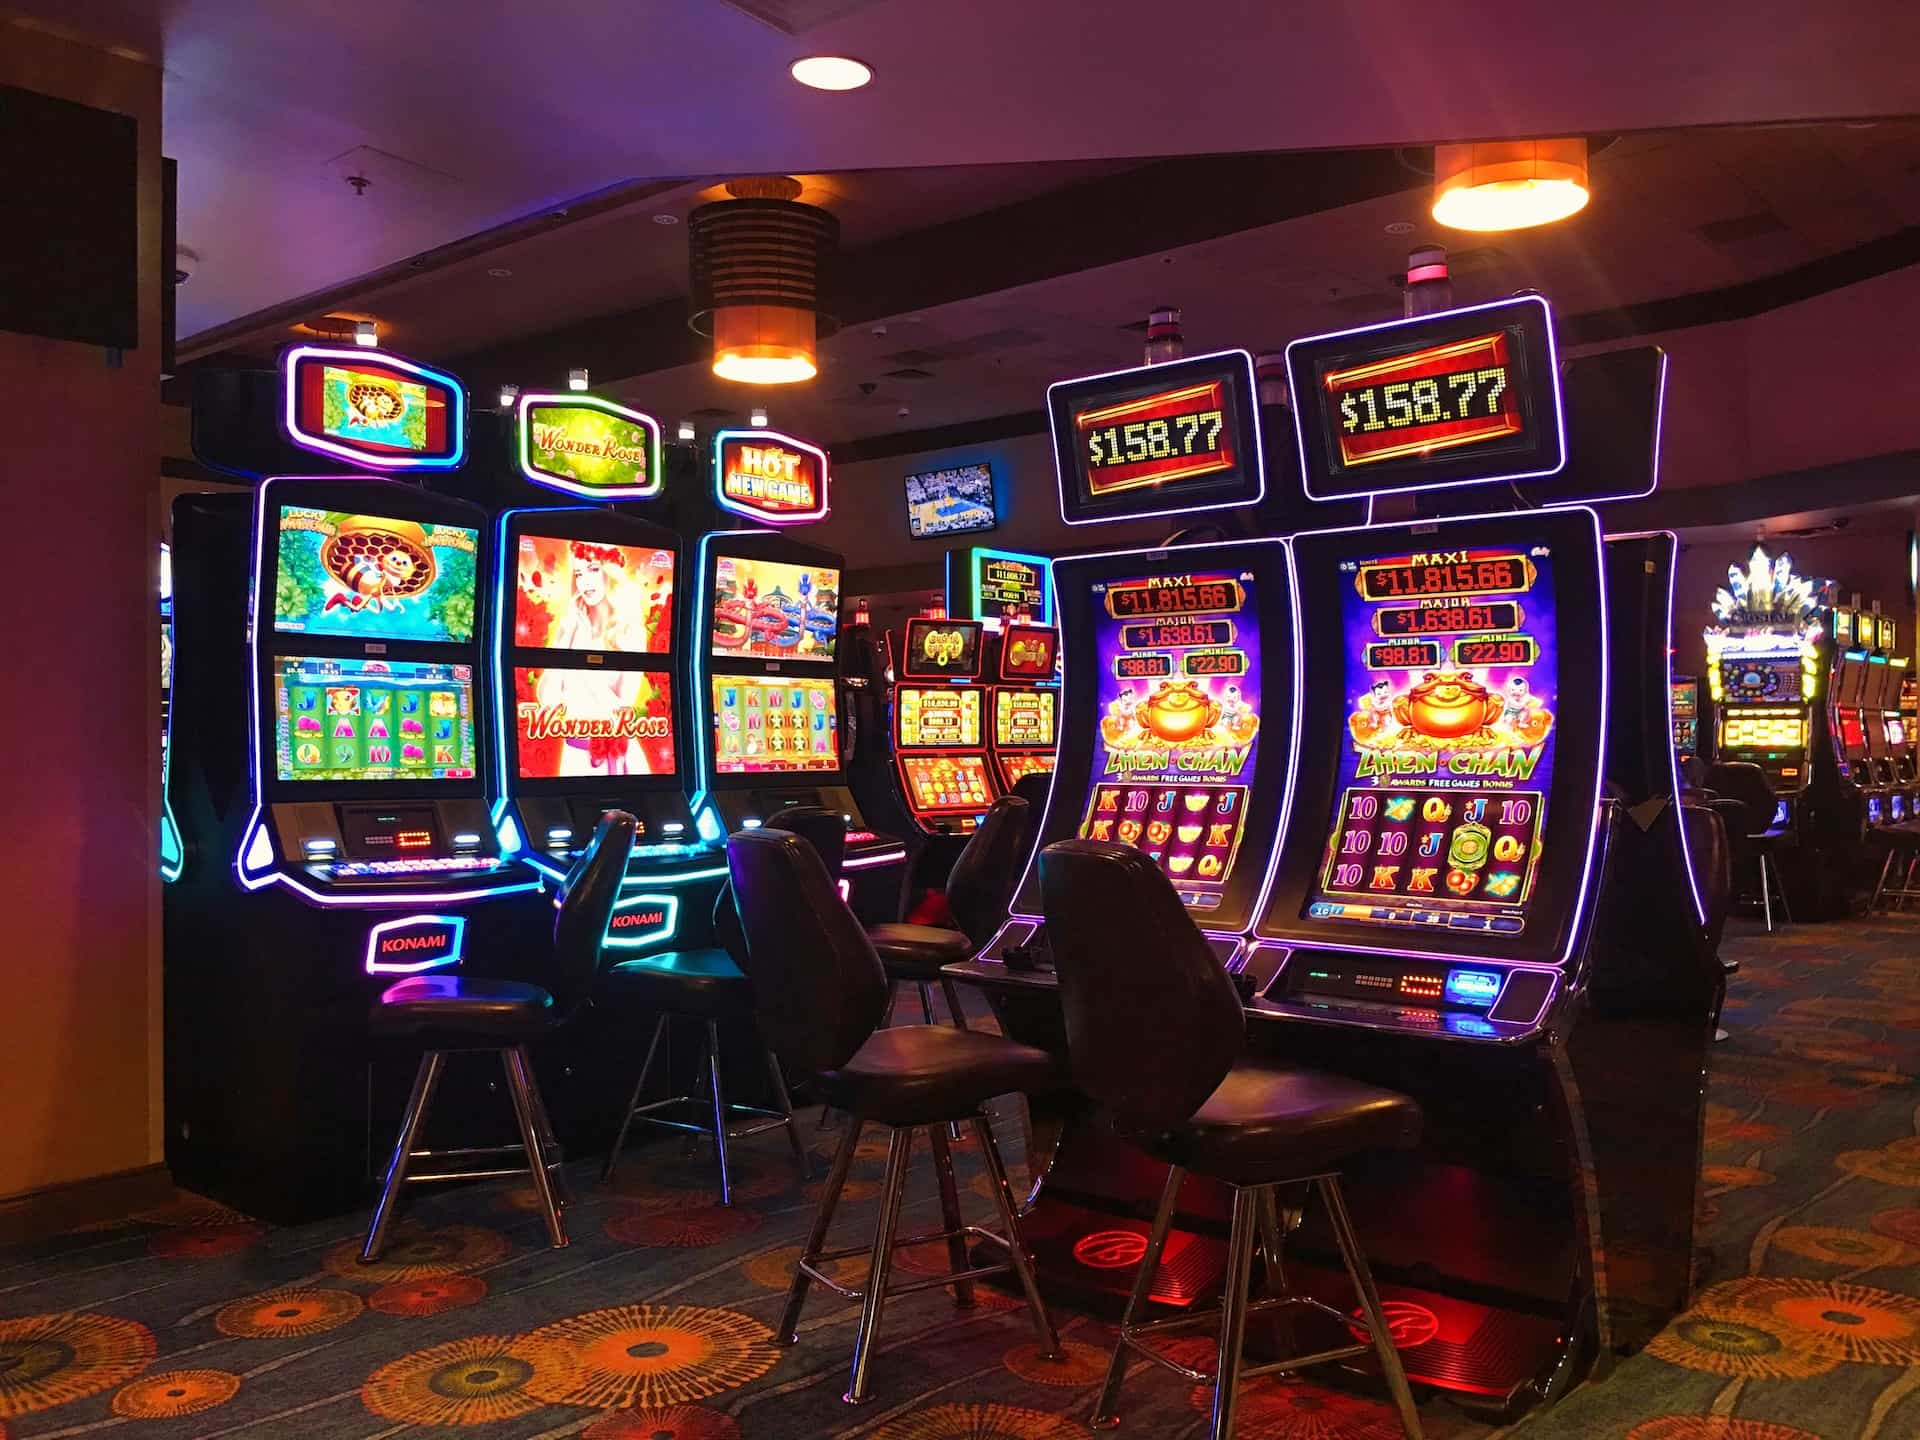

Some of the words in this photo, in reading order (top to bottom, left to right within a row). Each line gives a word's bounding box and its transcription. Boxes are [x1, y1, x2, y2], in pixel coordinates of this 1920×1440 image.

[1341, 367, 1506, 434] $158.77
[537, 426, 601, 457] WONDER
[602, 438, 645, 464] ROSE
[1088, 411, 1223, 466] $158.77
[741, 446, 801, 481] HOT
[728, 472, 765, 498] NEW
[767, 480, 811, 506] GAME
[1412, 550, 1469, 567] MAXI
[1148, 575, 1193, 589] MAXI
[1376, 562, 1513, 595] $11,815.66
[1121, 585, 1227, 614] $11,815.66
[1419, 597, 1471, 608] MAJOR
[1397, 607, 1496, 632] $1,638.61
[1138, 623, 1216, 647] $1,638.61
[1190, 655, 1238, 673] $22.90
[1375, 646, 1431, 666] $98.81
[1463, 643, 1525, 663] $22.90
[1122, 658, 1165, 675] $98.81
[296, 690, 316, 711] J
[401, 693, 419, 713] J
[434, 719, 453, 739] J
[521, 701, 613, 740] WONDER
[614, 707, 670, 739] ROSE
[434, 745, 456, 763] K
[1104, 746, 1170, 774] ZHEN
[1178, 744, 1252, 776] CHAN
[1355, 745, 1438, 778] ZHEN
[1449, 743, 1545, 781] CHAN
[1160, 774, 1178, 783] FREE
[1178, 775, 1201, 783] GAMES
[1371, 778, 1379, 787] 3
[1390, 779, 1427, 787] AWARDS
[1428, 778, 1450, 788] FREE
[1451, 778, 1481, 788] GAMES
[1482, 779, 1514, 788] BONUS
[1097, 790, 1121, 812] K
[1124, 790, 1149, 812] 10
[1156, 791, 1176, 812] J
[1217, 792, 1237, 814] J
[1349, 796, 1378, 820] 10
[1423, 797, 1452, 823] Q
[1464, 798, 1488, 823] J
[1499, 800, 1531, 825] 10
[1089, 820, 1115, 842] K
[1206, 823, 1233, 847] K
[1342, 830, 1371, 854] 10
[1377, 831, 1408, 856] 10
[1419, 832, 1444, 857] J
[1494, 835, 1526, 862] Q
[1197, 854, 1221, 876] Q
[1333, 863, 1363, 886] 10
[1370, 864, 1400, 889] K
[1407, 867, 1439, 892] K
[612, 911, 663, 929] KONAMI
[382, 934, 447, 954] KONAMI
